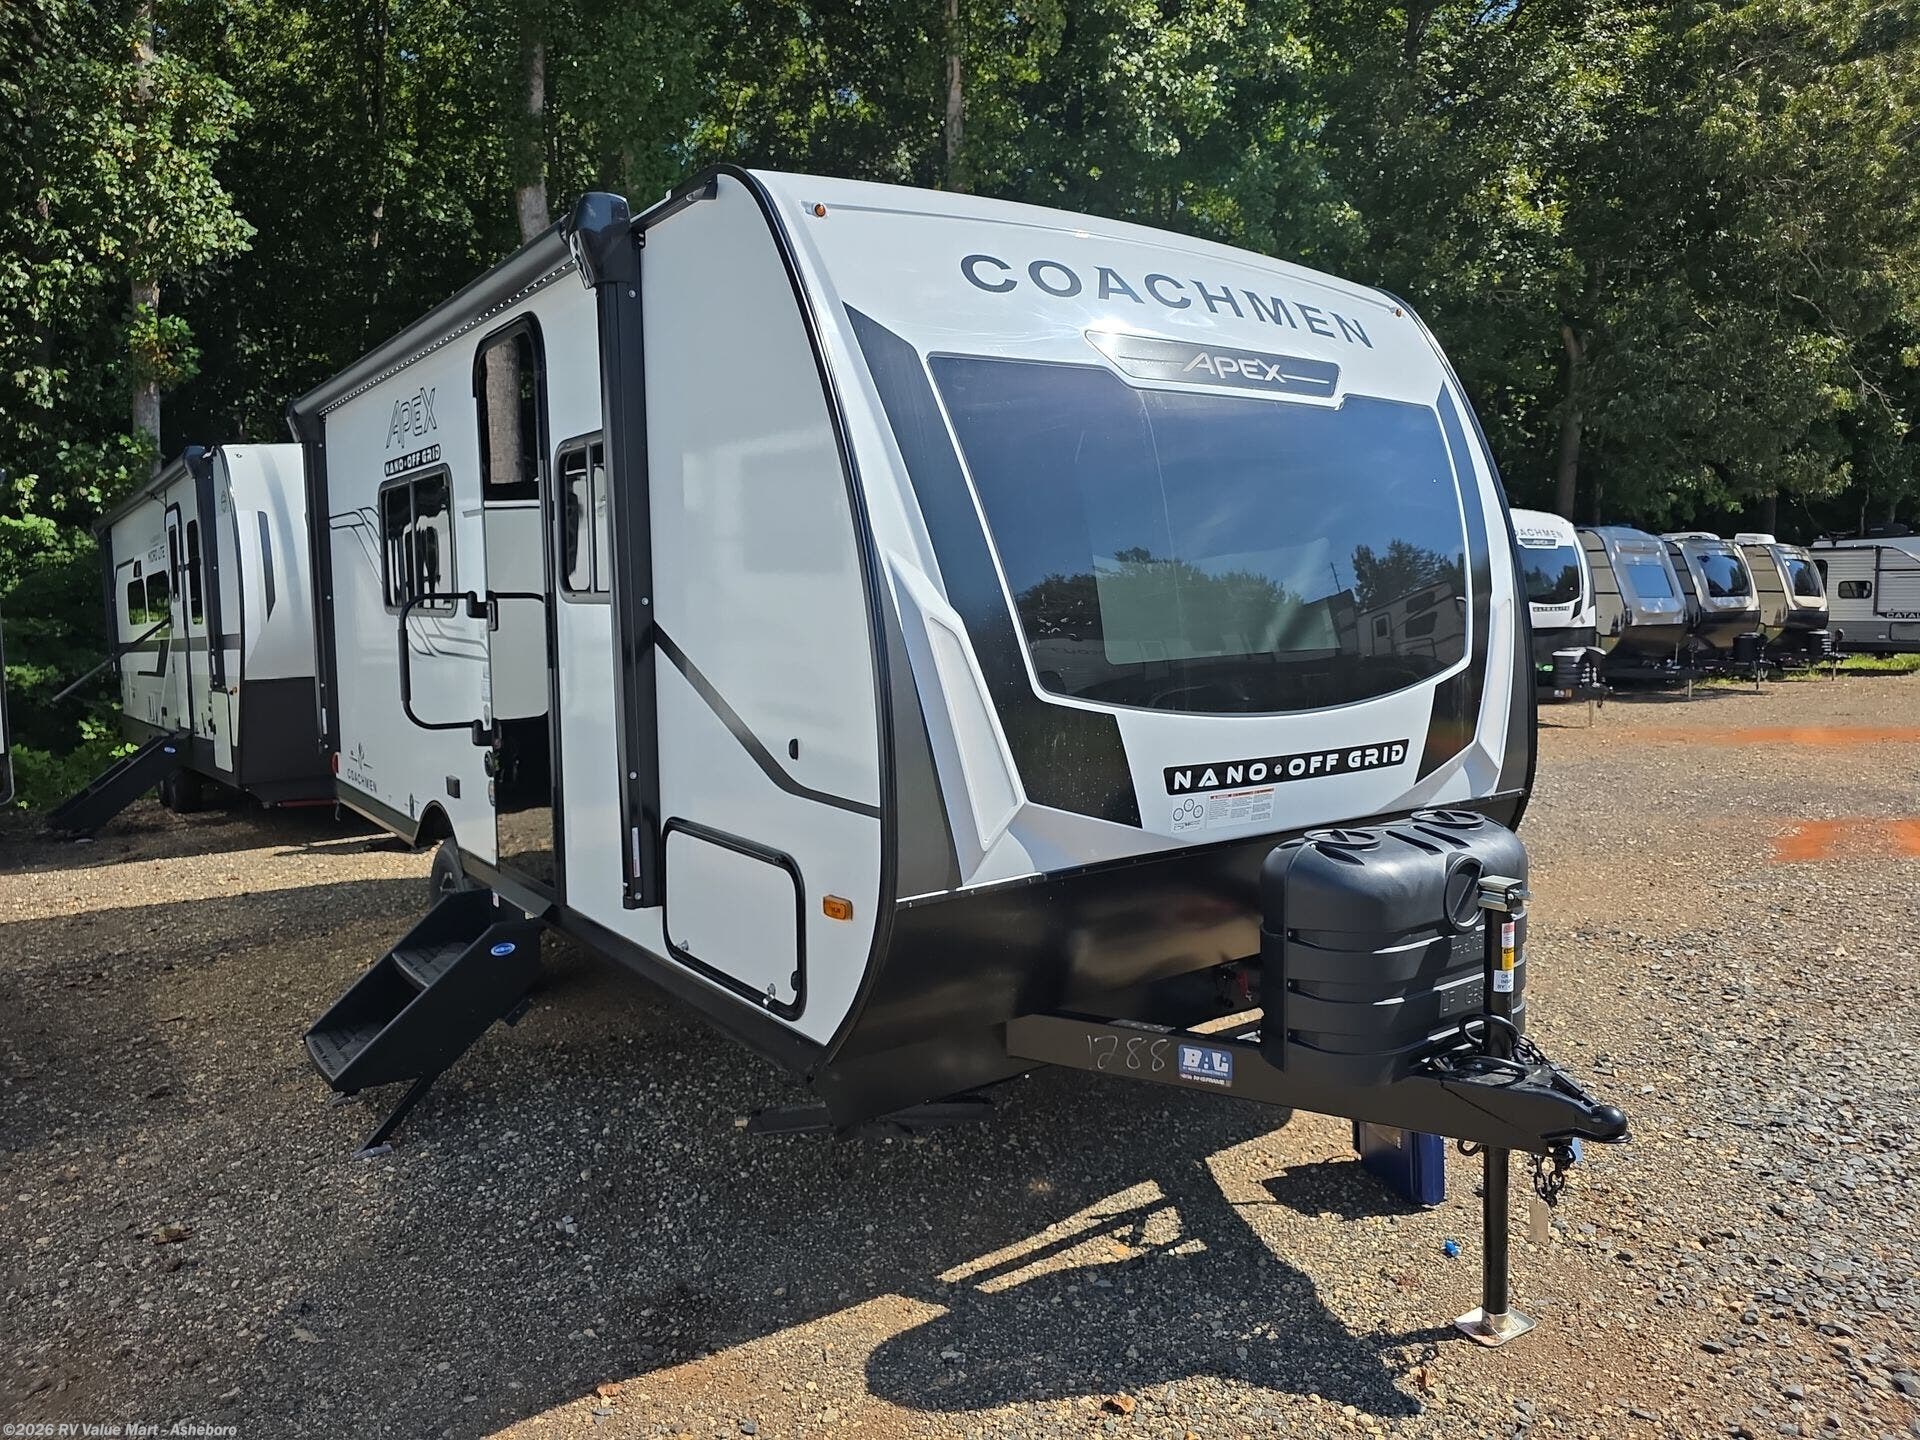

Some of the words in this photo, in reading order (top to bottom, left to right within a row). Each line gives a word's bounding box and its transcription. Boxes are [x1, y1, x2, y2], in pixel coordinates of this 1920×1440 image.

[960, 254, 1374, 349] COACHMEN
[1183, 351, 1286, 383] APEX
[386, 387, 437, 449] APEX
[1173, 762, 1268, 790] NANO
[1288, 753, 1339, 776] OFF
[1348, 744, 1404, 768] GRID
